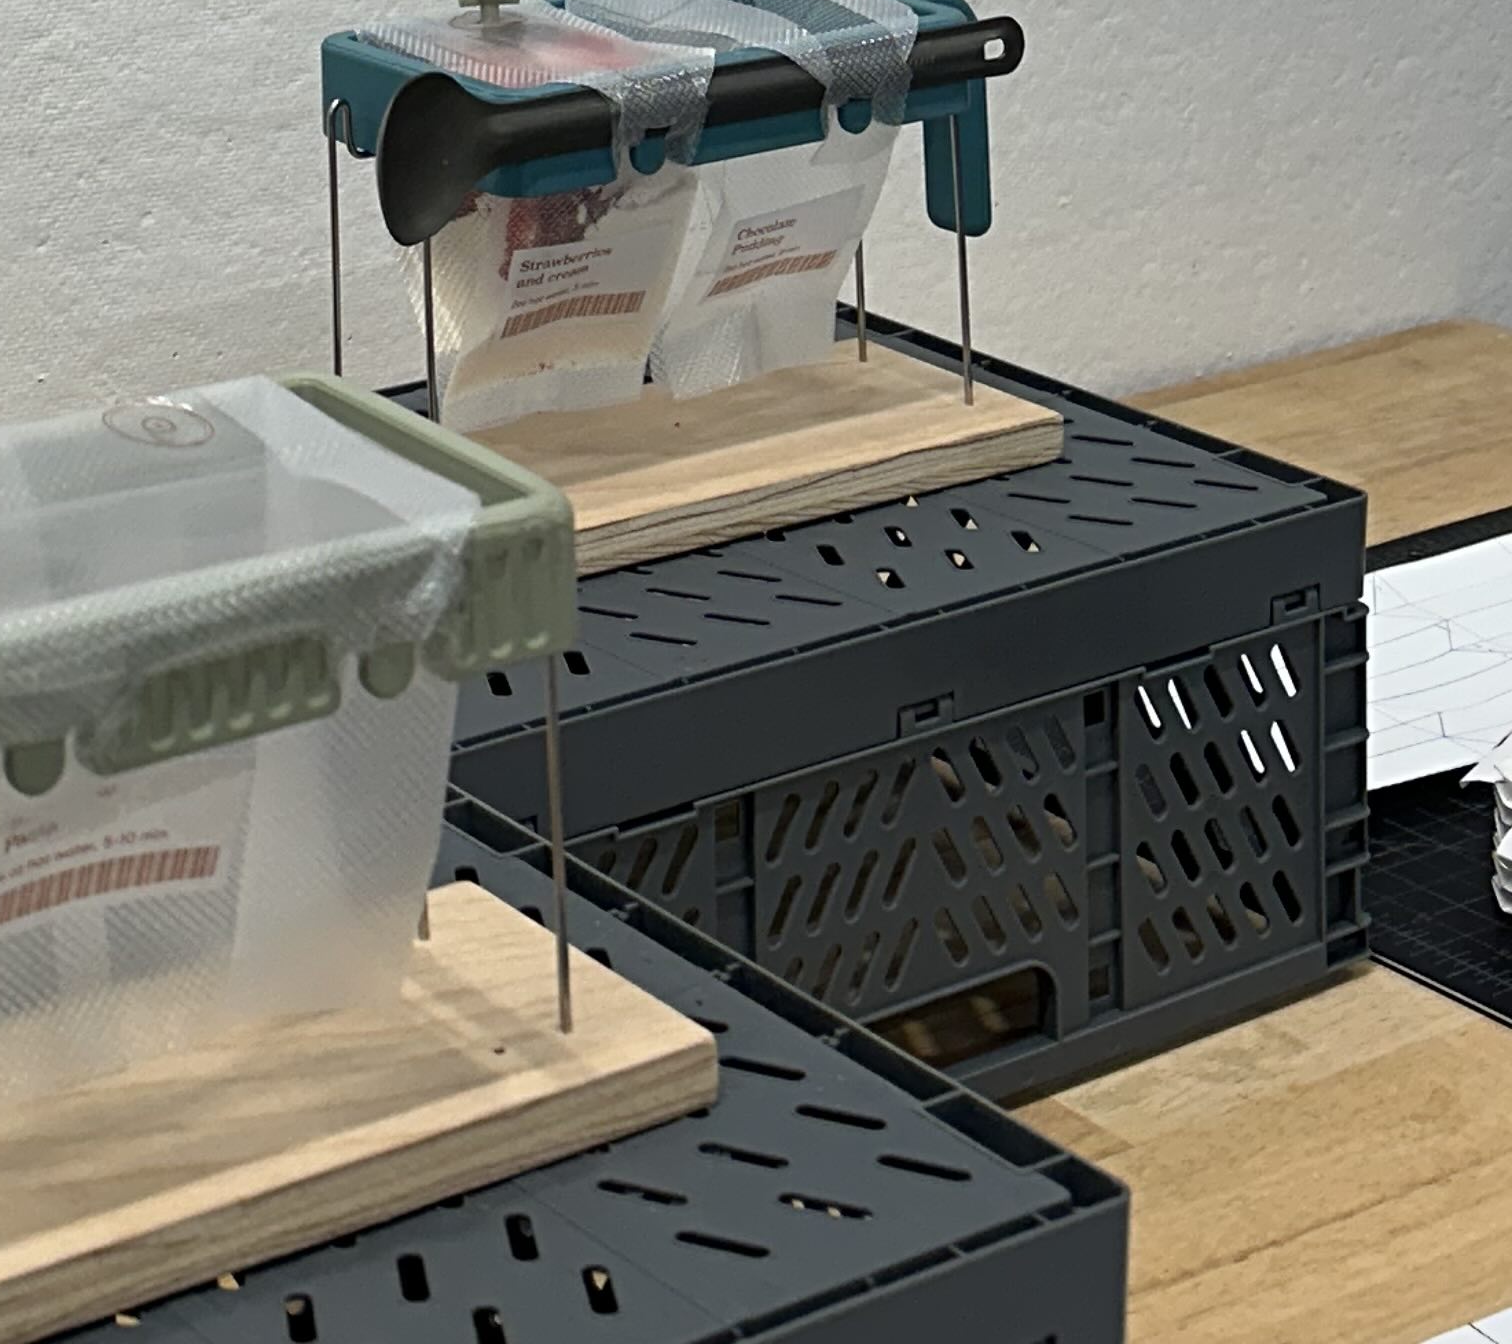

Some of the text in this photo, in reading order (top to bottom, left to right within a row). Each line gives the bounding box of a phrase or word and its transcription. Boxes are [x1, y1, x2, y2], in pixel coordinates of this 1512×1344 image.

[519, 247, 613, 273] Strawberries
[516, 265, 589, 288] and cream
